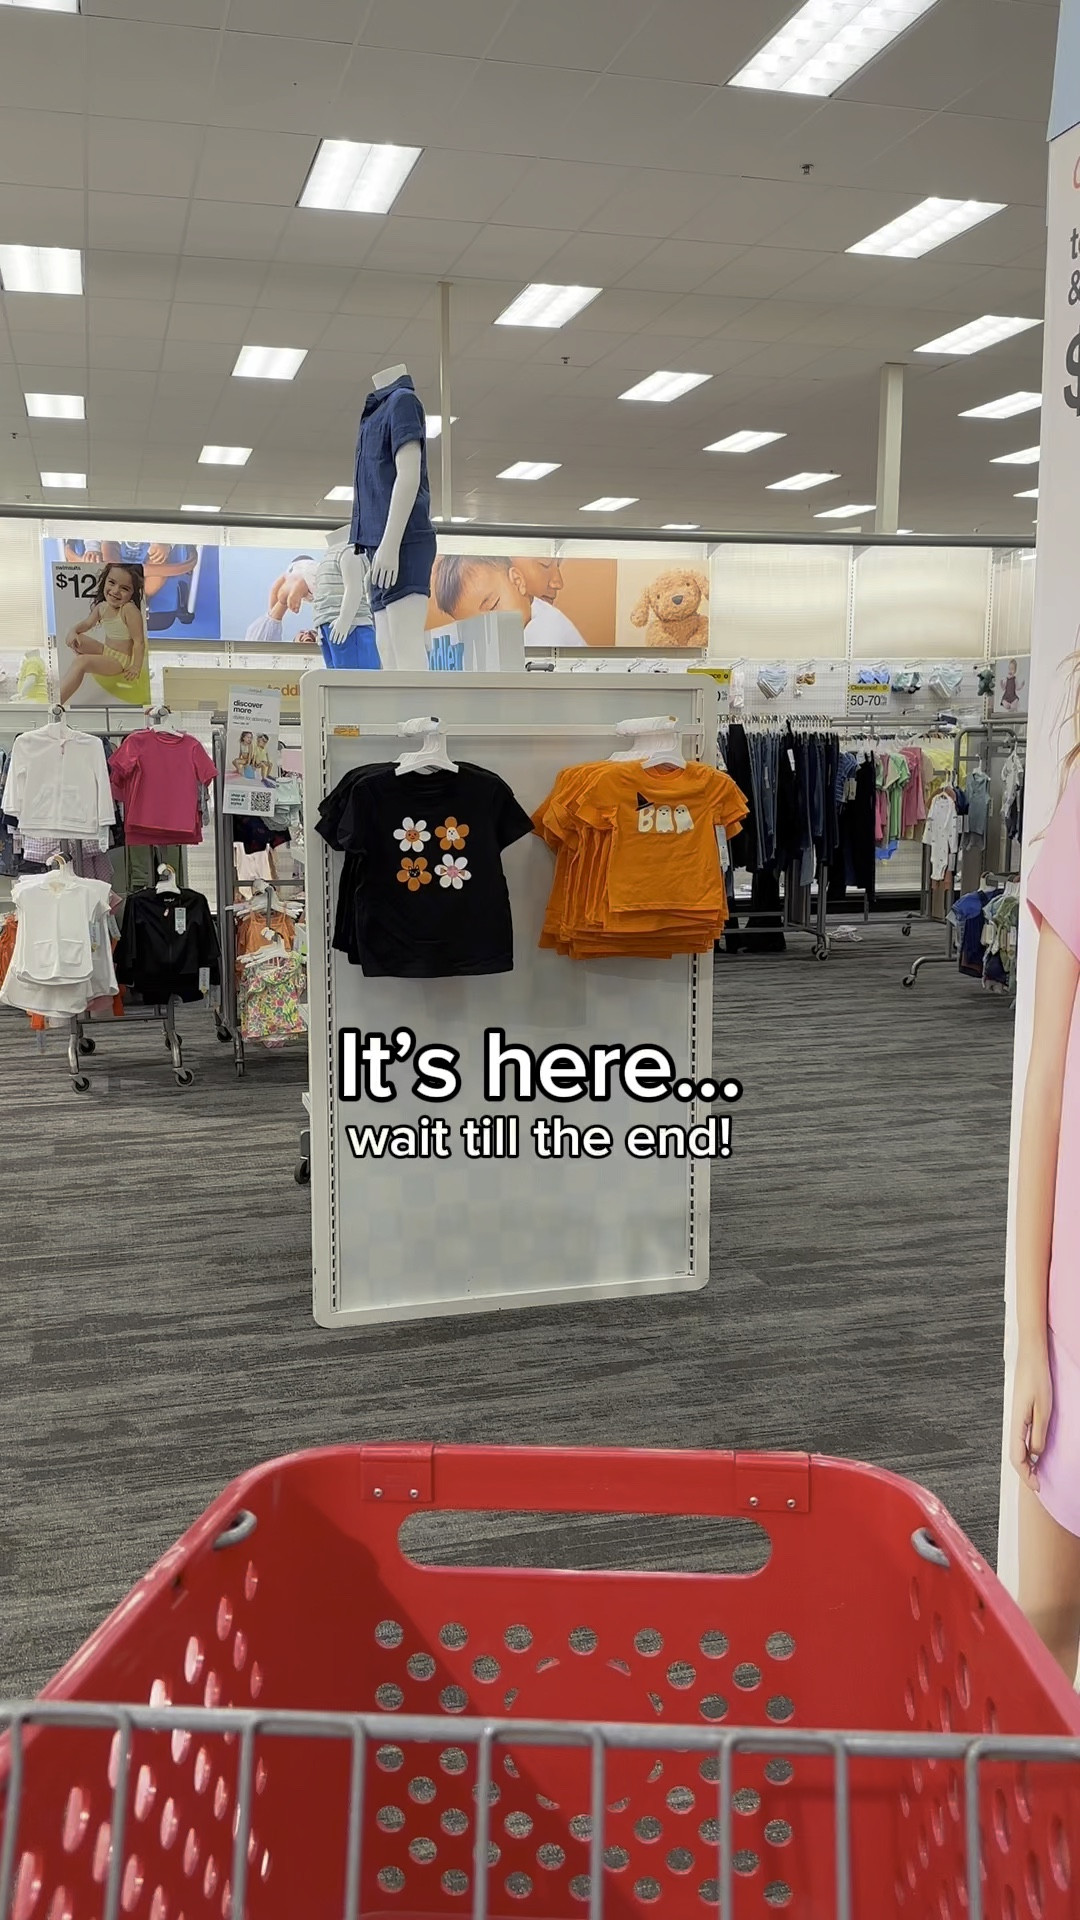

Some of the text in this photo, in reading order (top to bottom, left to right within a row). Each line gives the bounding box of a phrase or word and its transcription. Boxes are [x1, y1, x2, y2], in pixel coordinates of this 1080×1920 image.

[56, 572, 97, 598] $12
[233, 700, 263, 709] discover
[850, 695, 881, 706] 50-70
